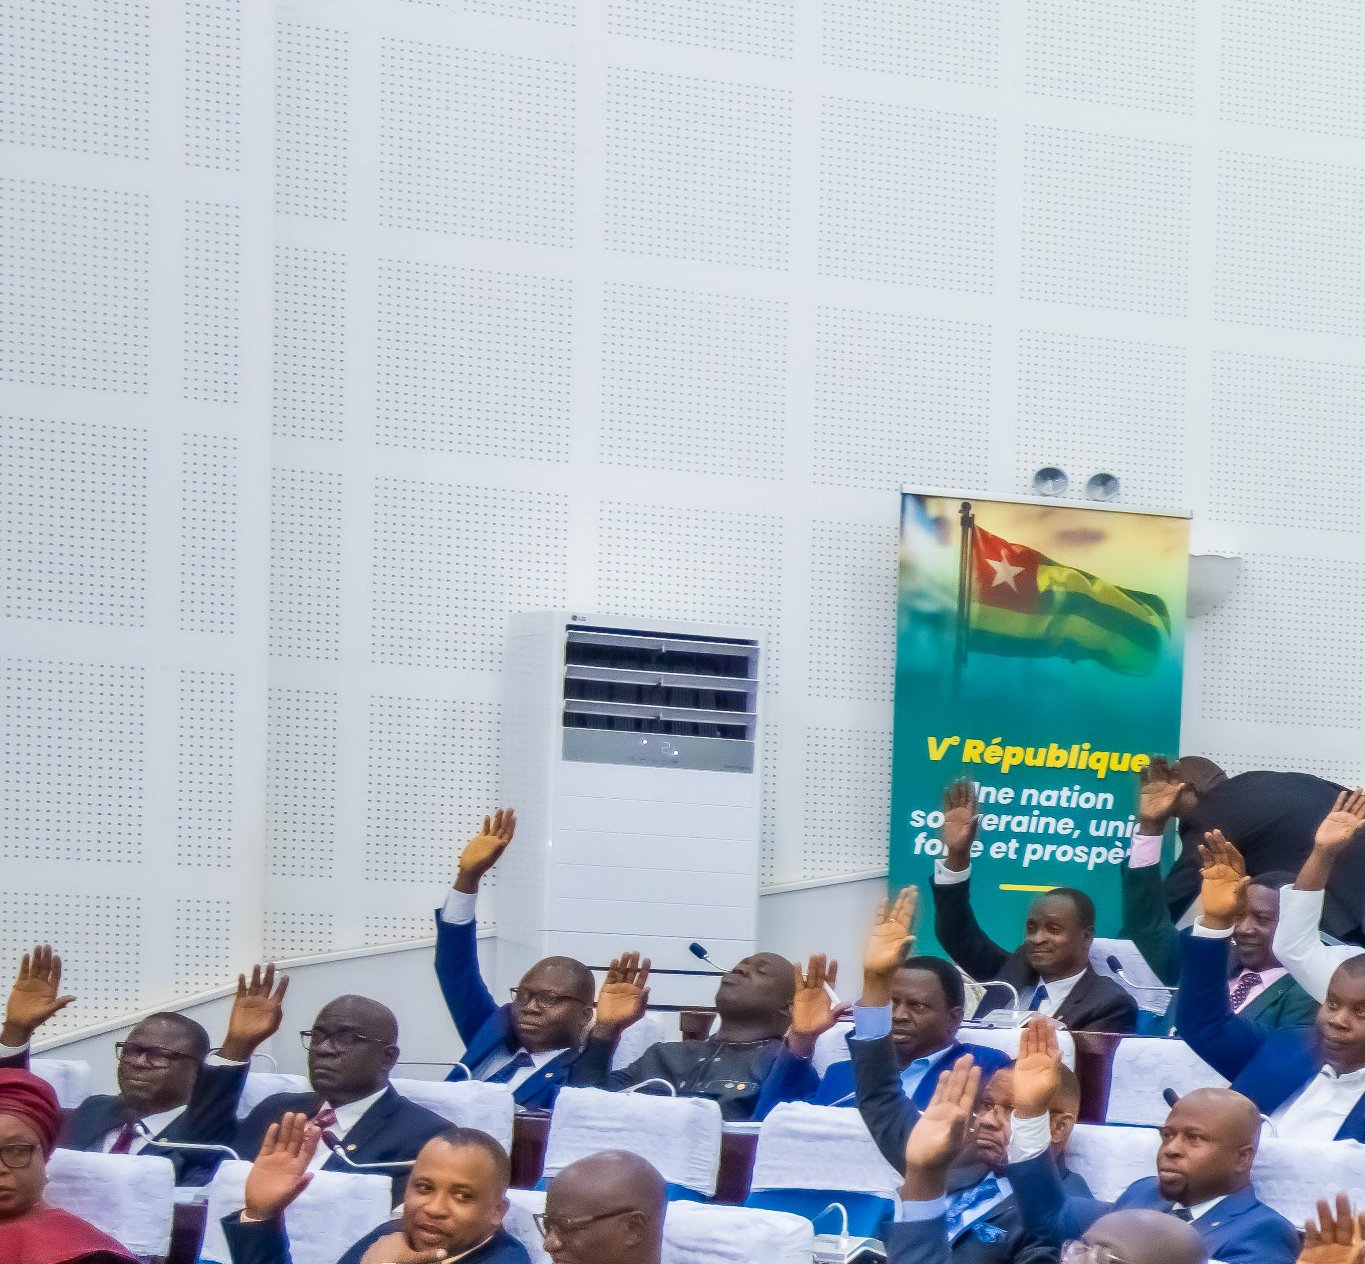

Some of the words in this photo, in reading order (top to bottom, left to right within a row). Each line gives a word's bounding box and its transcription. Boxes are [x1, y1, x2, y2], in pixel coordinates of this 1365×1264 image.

[962, 737, 1150, 778] République
[1020, 785, 1114, 809] nation
[910, 810, 1081, 838] soeraine,
[913, 832, 984, 858] foe
[990, 838, 1018, 860] et
[1022, 841, 1131, 870] prospè
